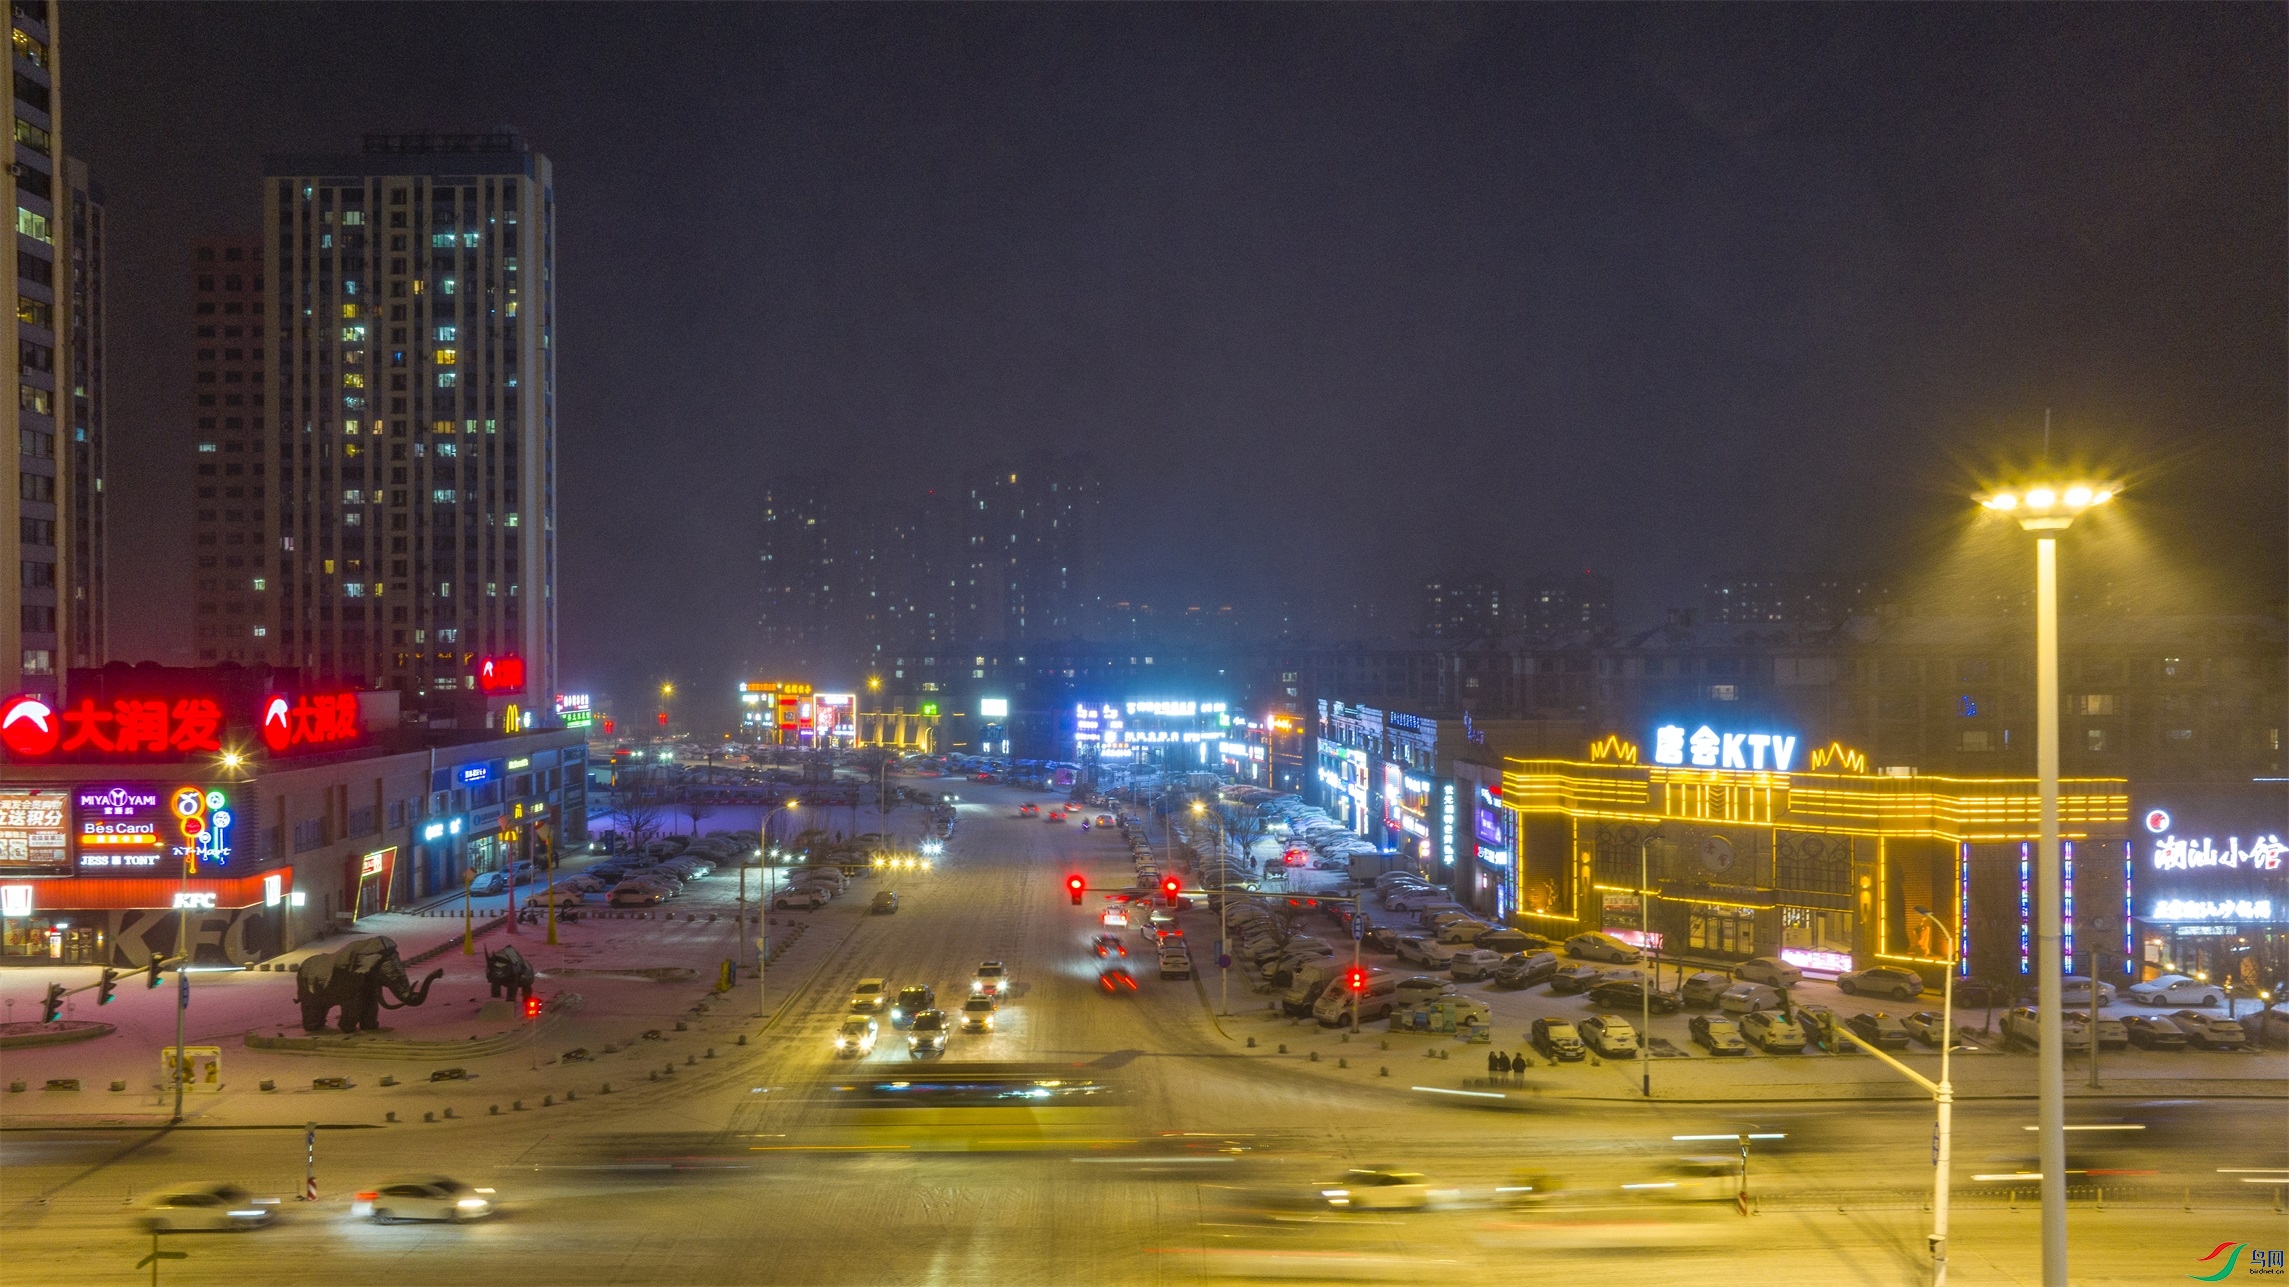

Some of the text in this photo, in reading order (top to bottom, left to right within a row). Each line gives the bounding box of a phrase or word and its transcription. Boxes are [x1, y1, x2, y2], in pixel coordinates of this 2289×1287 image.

[62, 699, 221, 751] 大润发
[1655, 725, 1796, 770] 唐会KTV
[116, 823, 154, 833] Carol
[81, 856, 109, 865] JESS
[2154, 835, 2289, 869] 潮汕小馆
[173, 893, 216, 908] KFC
[109, 907, 263, 969] KFC
